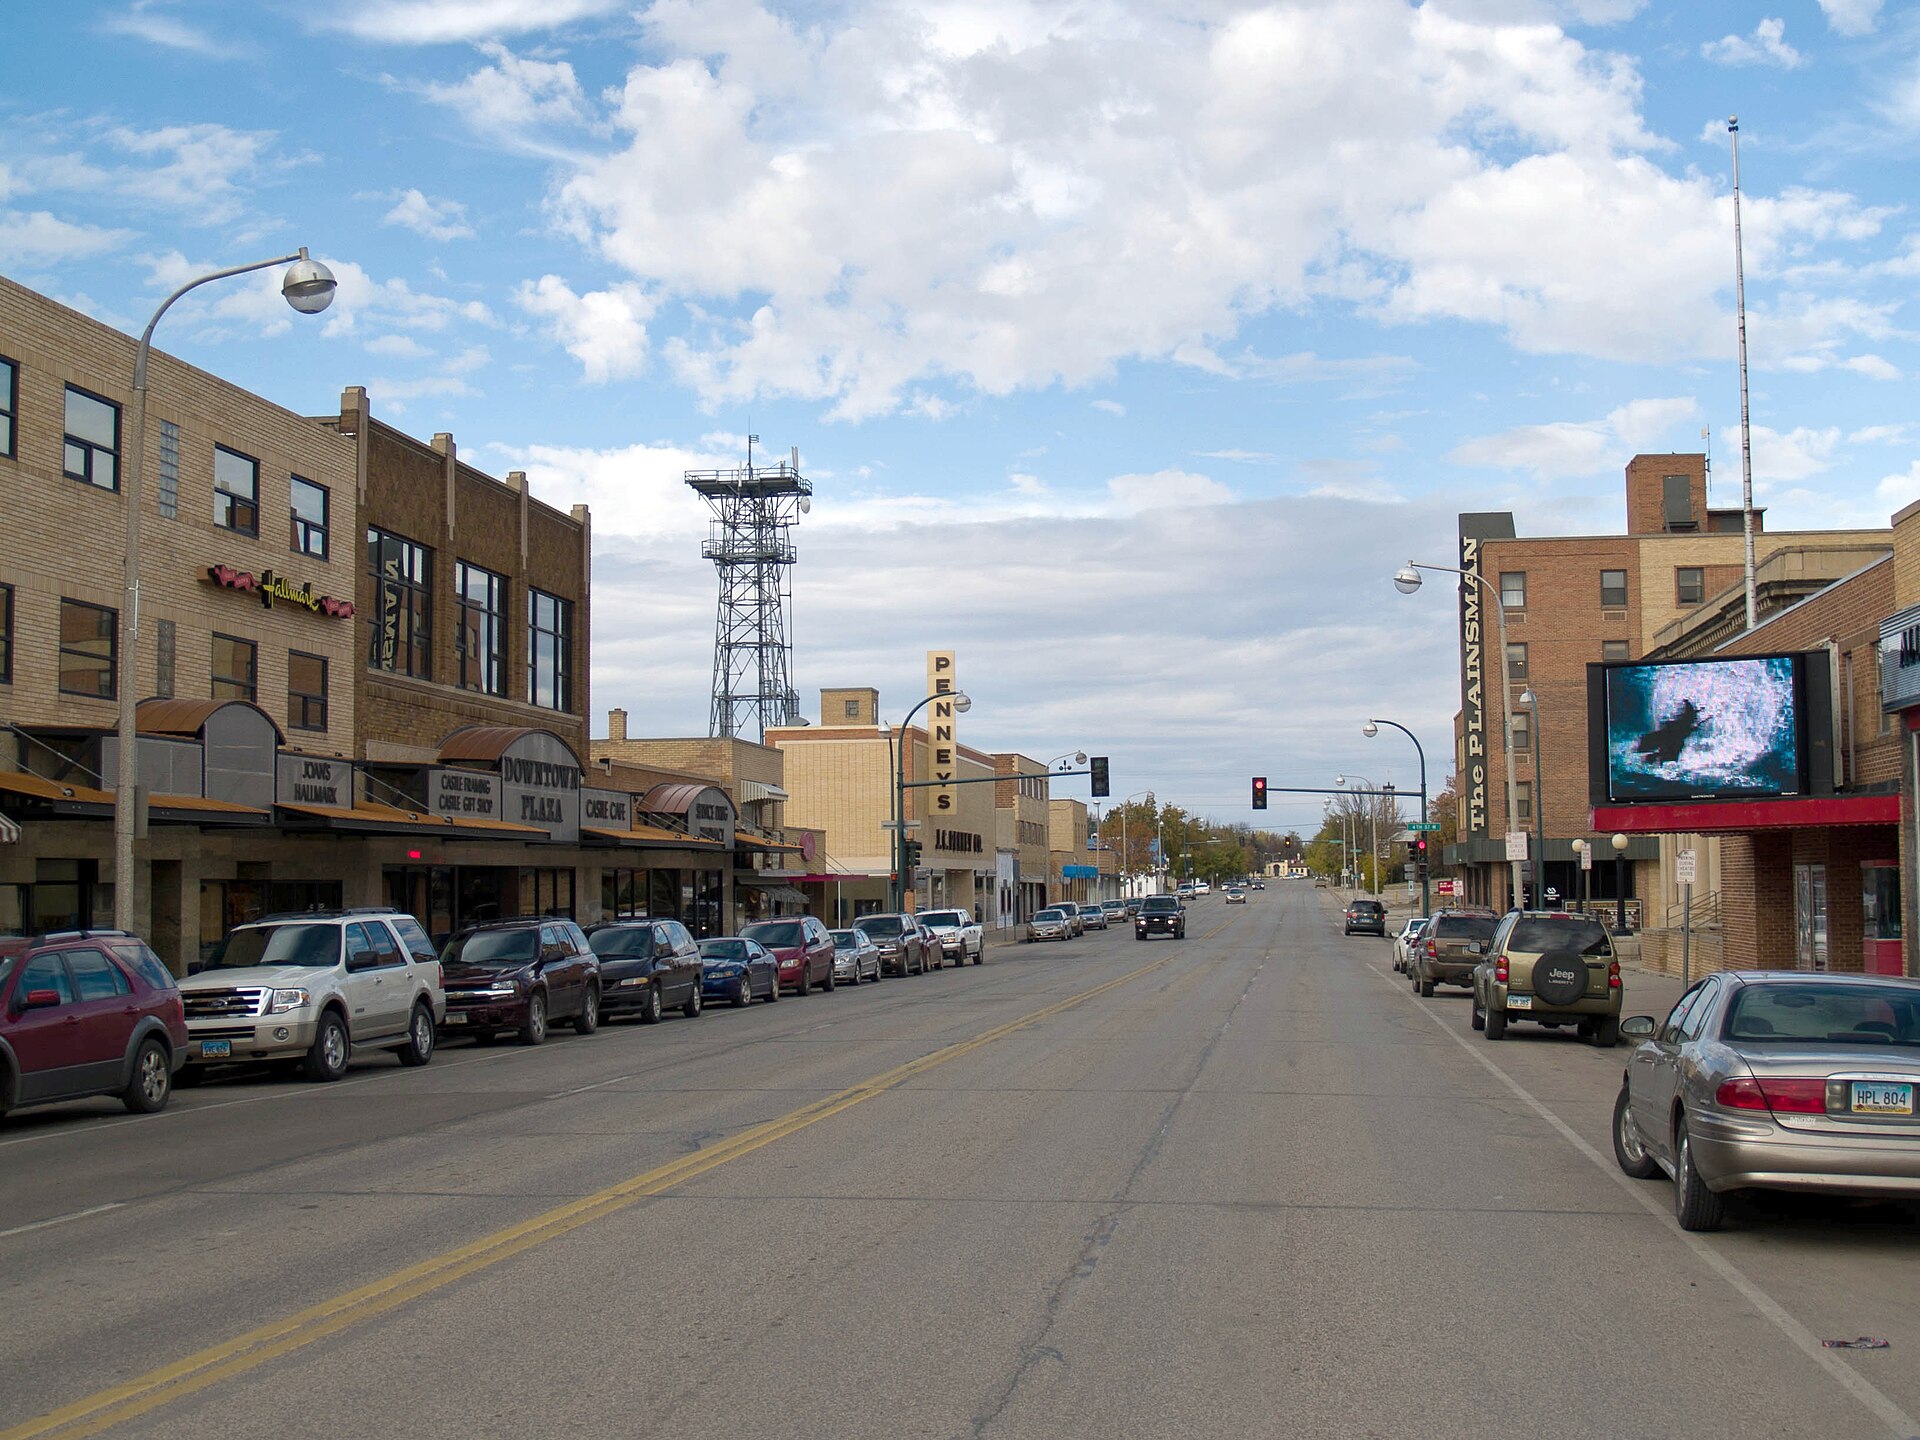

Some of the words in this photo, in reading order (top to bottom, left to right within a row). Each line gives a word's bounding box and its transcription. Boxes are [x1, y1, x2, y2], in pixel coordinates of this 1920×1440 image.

[262, 571, 319, 612] Hallmark
[1463, 536, 1485, 758] PLAINSMAN
[935, 656, 951, 810] PENNEYS
[504, 756, 578, 790] DOWNTOWN
[294, 783, 337, 804] HALLMARK
[521, 795, 563, 823] PLAZA
[1549, 968, 1575, 980] Jeep
[1857, 1090, 1880, 1105] HPL
[1883, 1091, 1906, 1106] 804
